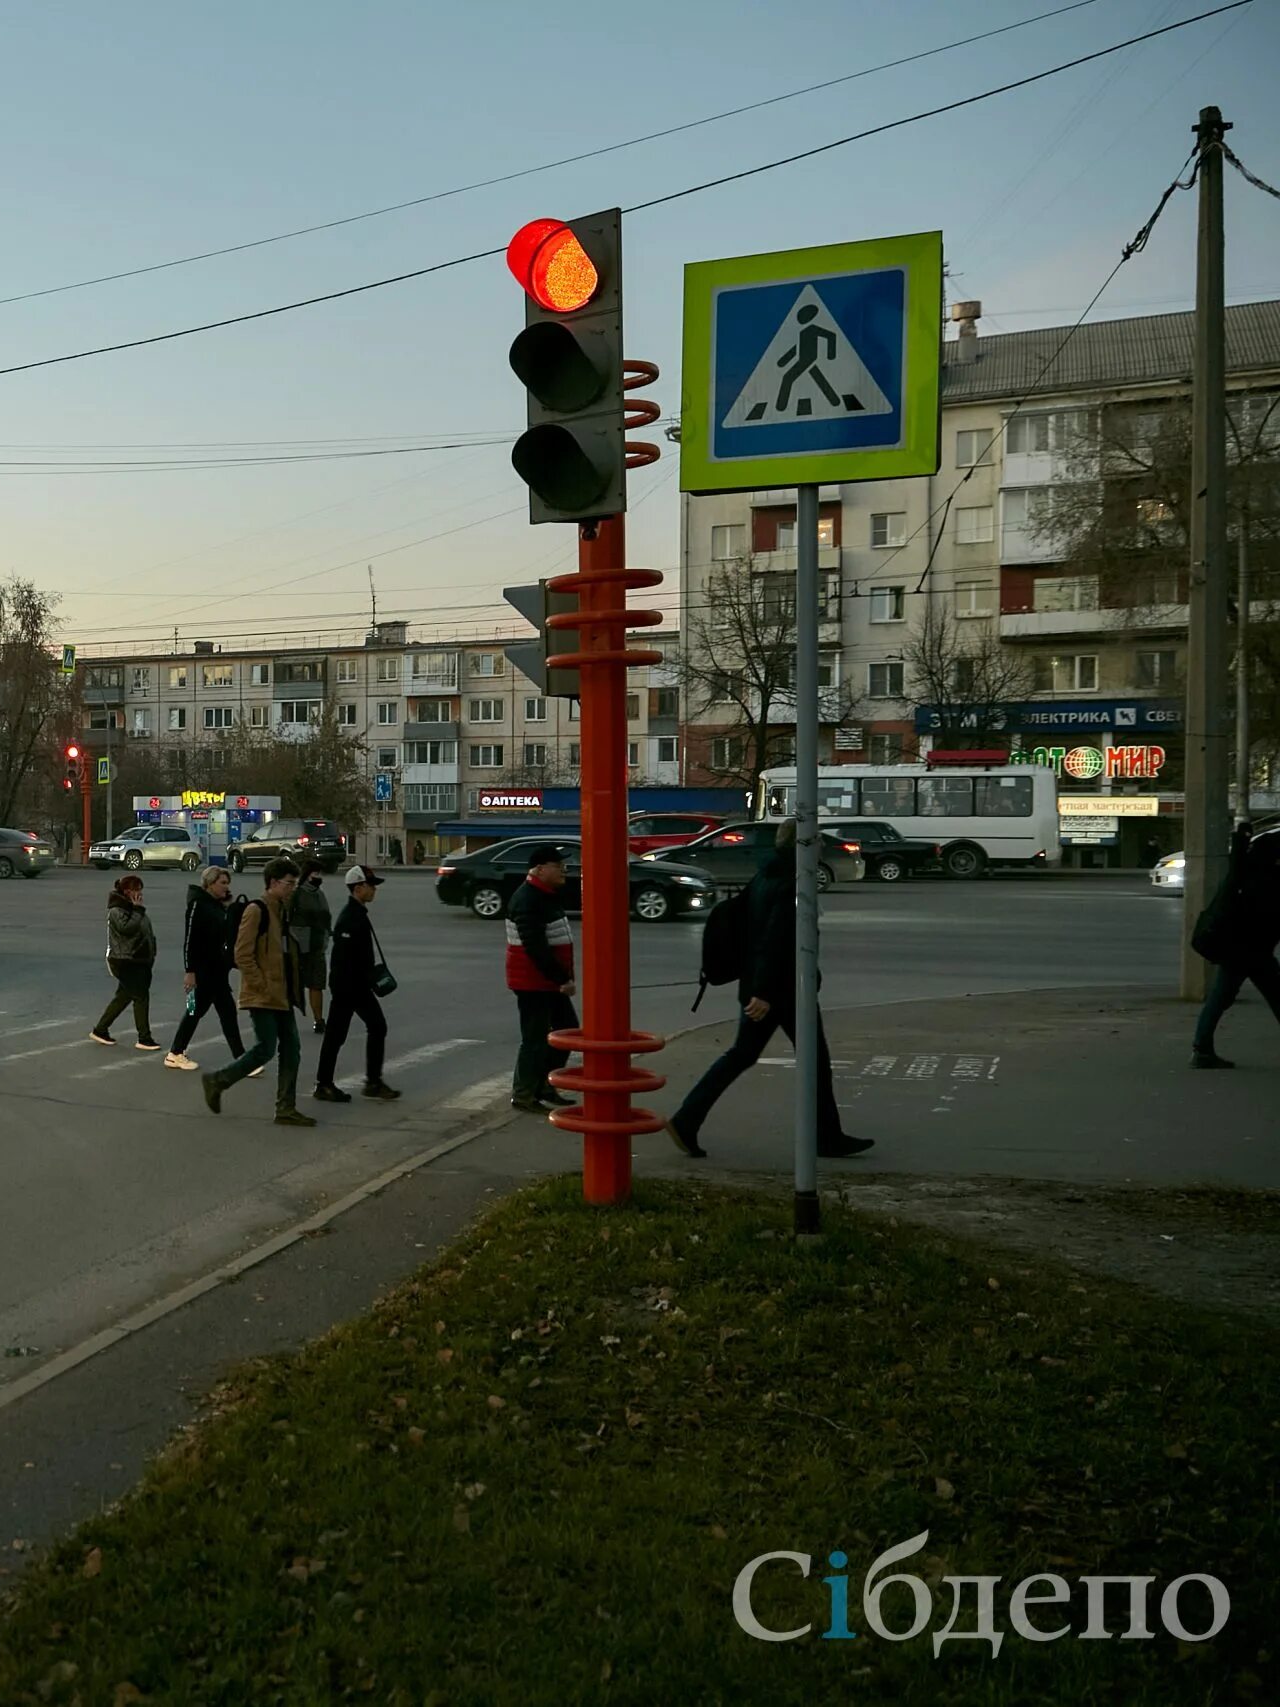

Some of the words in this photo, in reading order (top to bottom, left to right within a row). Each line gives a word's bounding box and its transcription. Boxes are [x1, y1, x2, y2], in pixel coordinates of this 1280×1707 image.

[1020, 711, 1111, 725] ЭЛЕКТРИКА
[1105, 745, 1166, 779] МИР
[181, 790, 226, 808] ЦВЕТЫ
[491, 796, 540, 806] АПТЕКА
[1093, 803, 1153, 813] мастерская
